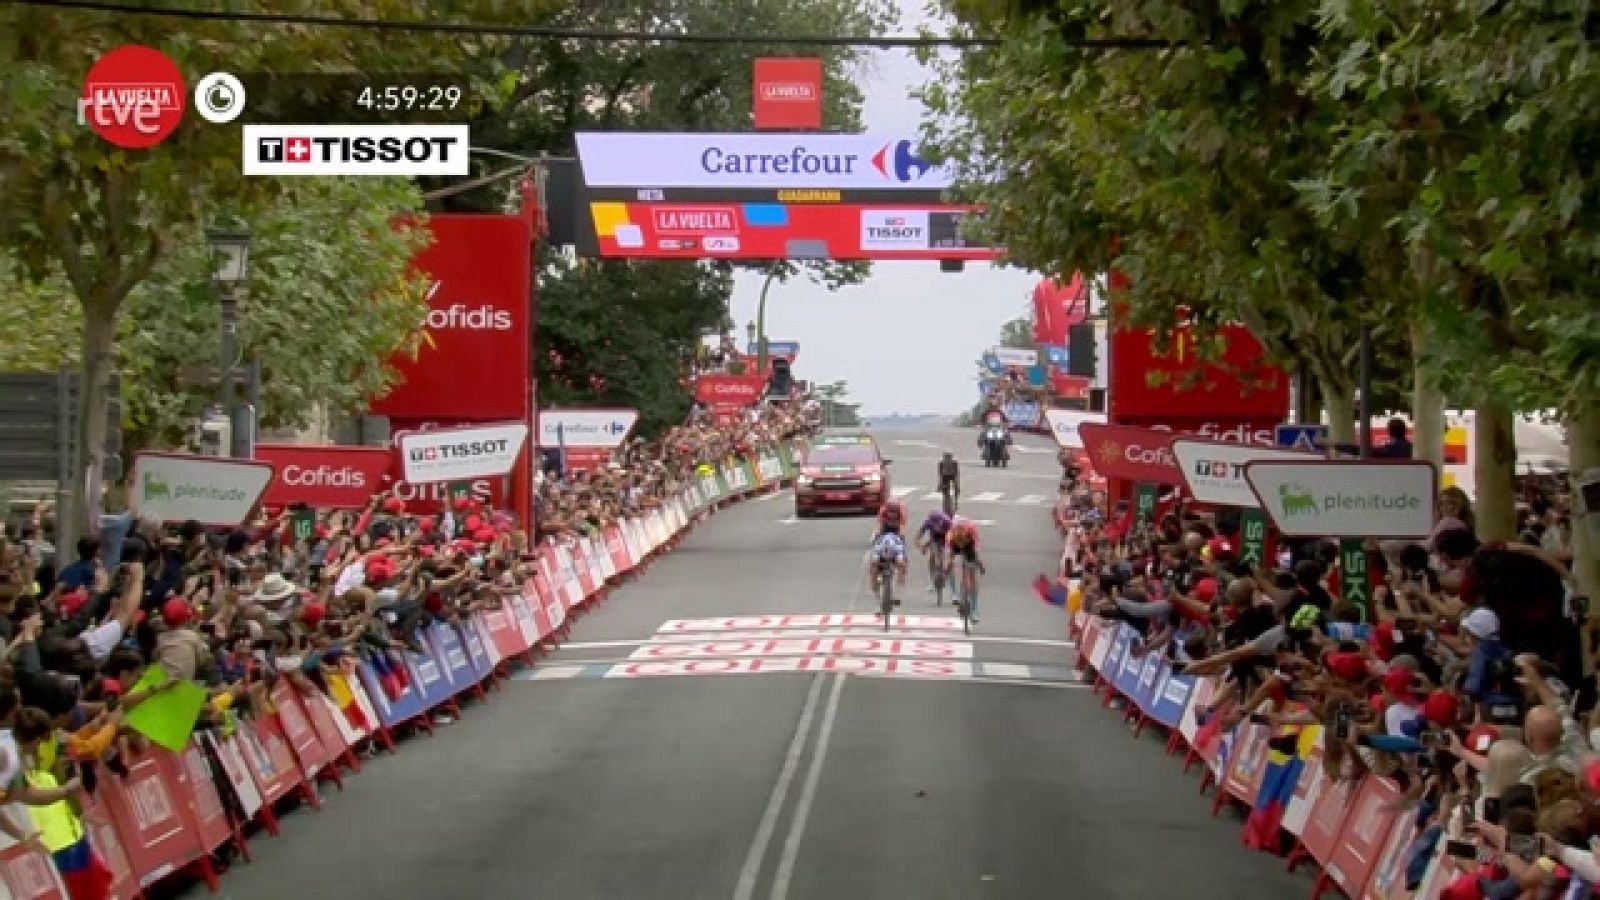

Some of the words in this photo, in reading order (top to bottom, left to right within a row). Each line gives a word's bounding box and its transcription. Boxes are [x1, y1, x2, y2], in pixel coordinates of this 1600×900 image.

[700, 147, 858, 173] Carrefour
[866, 226, 922, 239] TISSOT
[420, 302, 512, 331] ofidis
[439, 439, 508, 459] TISSOT
[282, 464, 366, 487] Cofidis
[1324, 492, 1420, 511] plenitude
